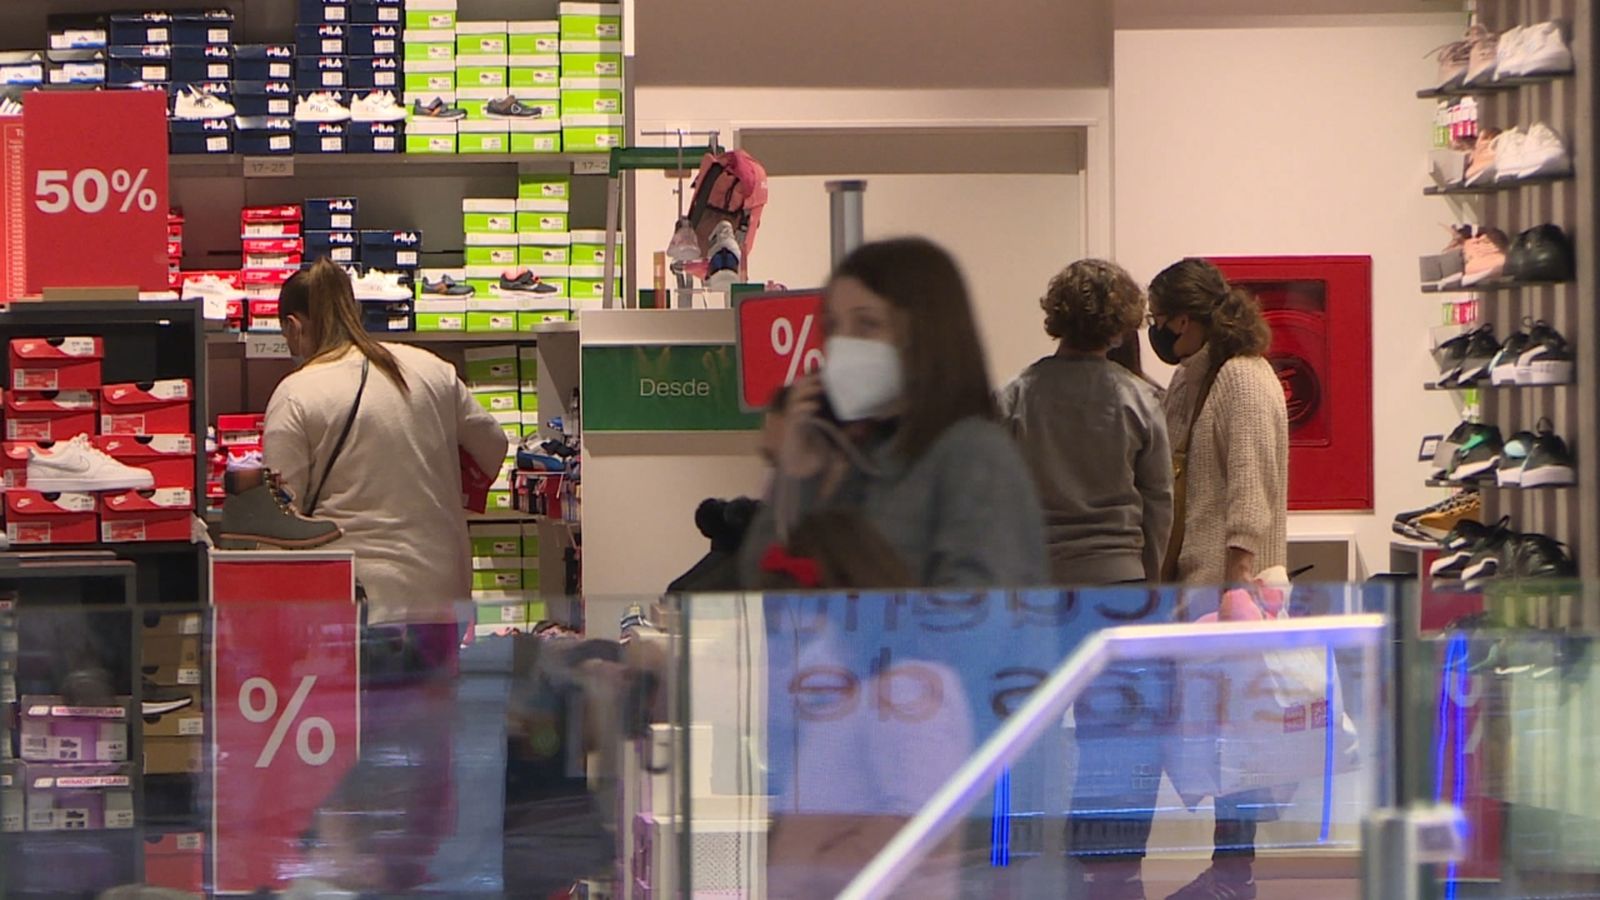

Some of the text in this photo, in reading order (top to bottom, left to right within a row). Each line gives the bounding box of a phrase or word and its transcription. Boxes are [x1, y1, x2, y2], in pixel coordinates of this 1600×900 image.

[319, 25, 343, 36] FILA
[372, 25, 396, 36] FILA
[205, 46, 229, 57] FILA
[266, 47, 290, 57] FILA
[319, 58, 342, 68] FILA
[372, 58, 396, 68] FILA
[203, 83, 227, 93] FILA
[266, 82, 290, 93] FILA
[204, 119, 228, 130] FILA
[266, 118, 291, 129] FILA
[318, 123, 342, 134] FILA
[371, 123, 395, 134] FILA
[583, 161, 609, 170] 17-2
[35, 168, 158, 214] 50%
[329, 200, 353, 210] FILA
[329, 233, 353, 243] FILA
[393, 232, 417, 242] FILA
[254, 343, 288, 353] 17-25
[771, 314, 824, 387] %
[640, 378, 710, 397] Desde
[238, 675, 336, 767] %
